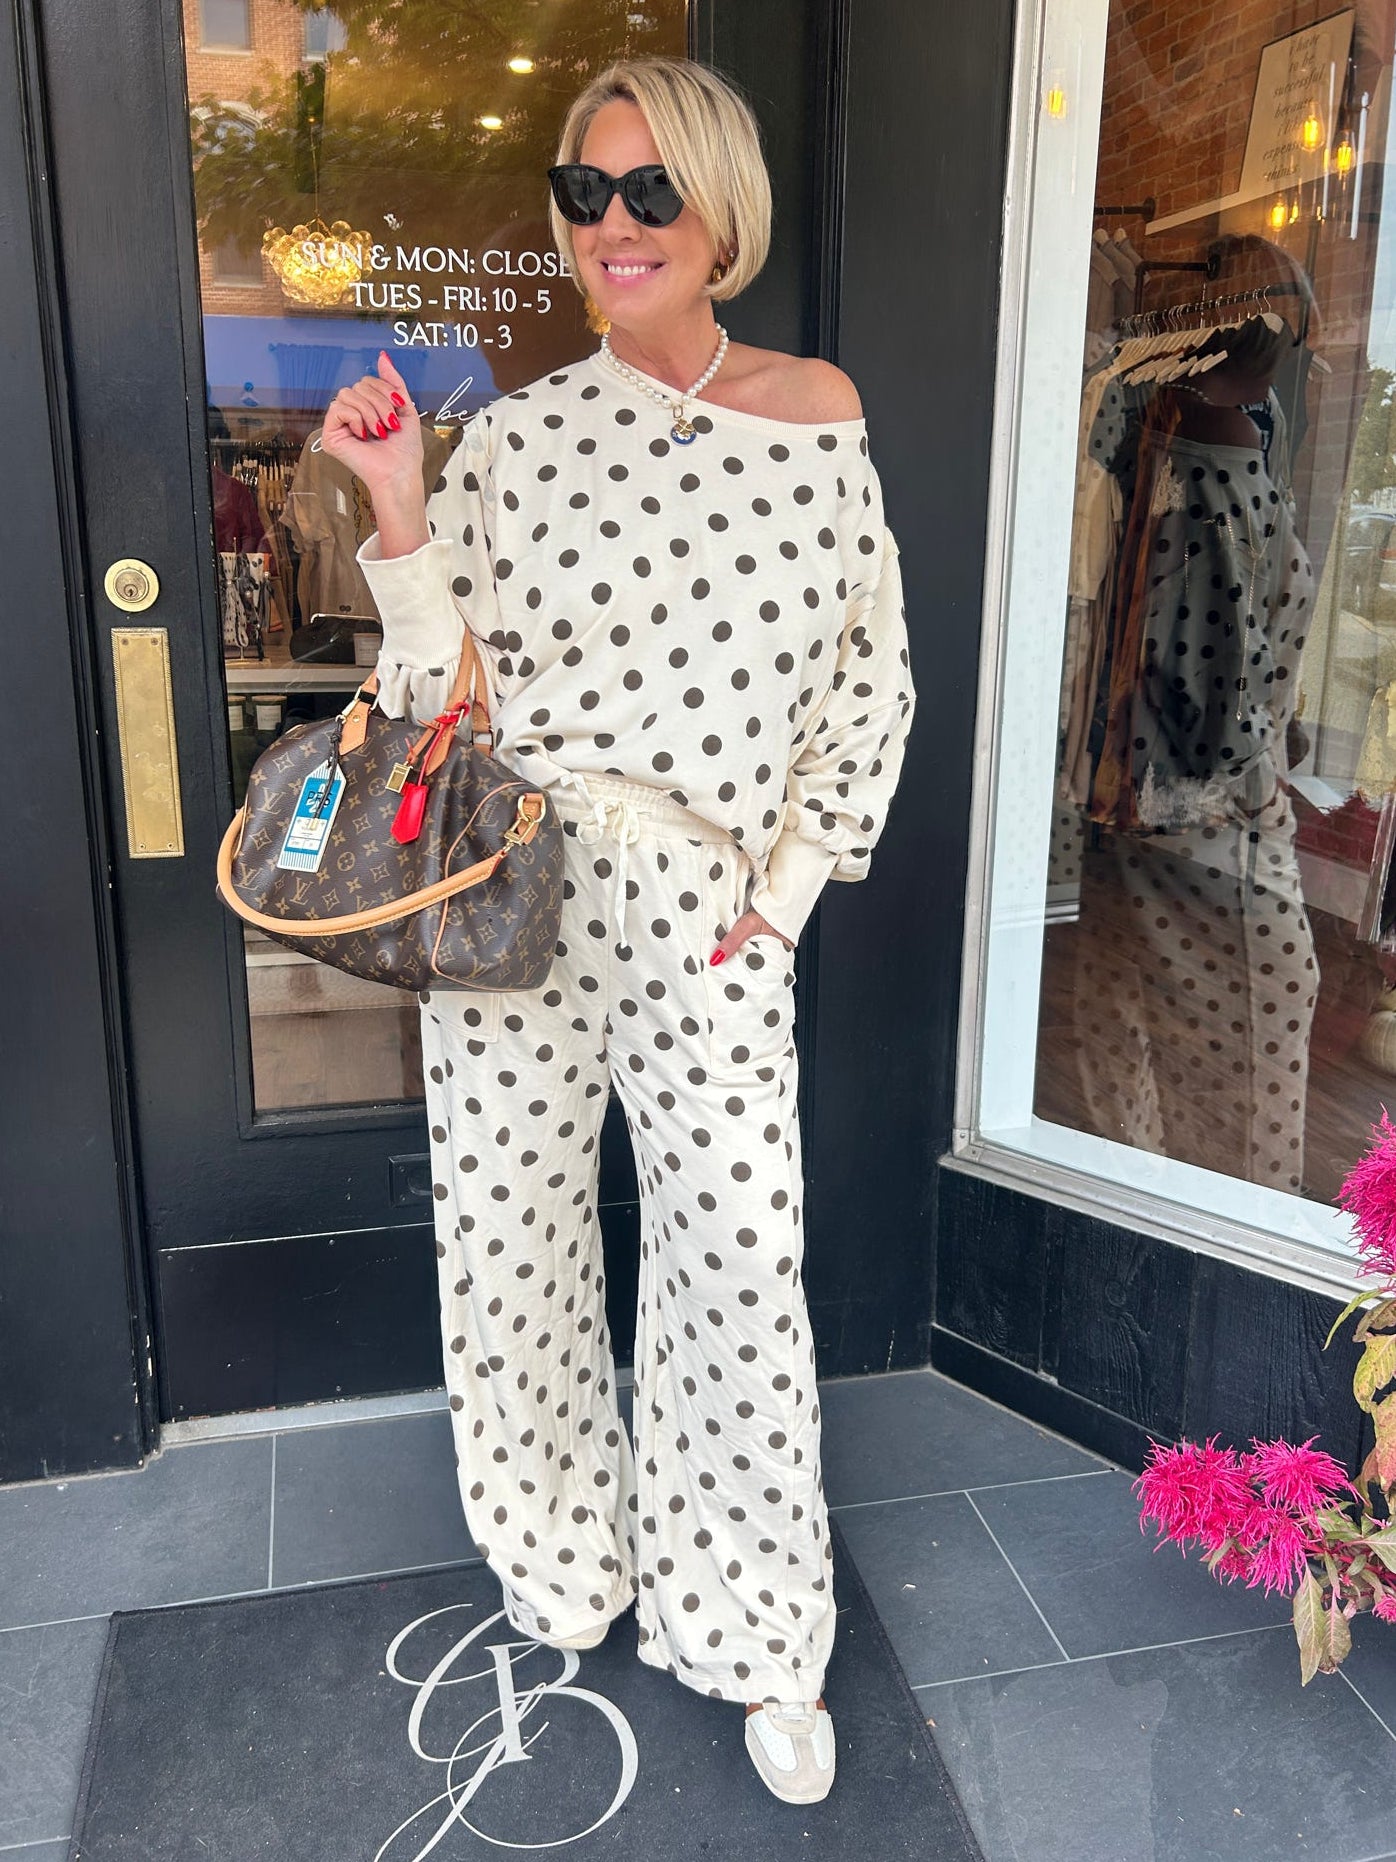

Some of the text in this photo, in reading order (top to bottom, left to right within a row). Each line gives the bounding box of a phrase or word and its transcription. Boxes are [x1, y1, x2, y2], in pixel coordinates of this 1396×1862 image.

[301, 241, 574, 278] SUN & MON: CLOSE
[349, 281, 422, 310] TUES
[444, 286, 488, 312] FRI:
[493, 288, 517, 313] 10
[537, 289, 552, 314] 5
[393, 322, 448, 347] SAT:
[454, 323, 478, 348] 10
[499, 324, 513, 349] 3
